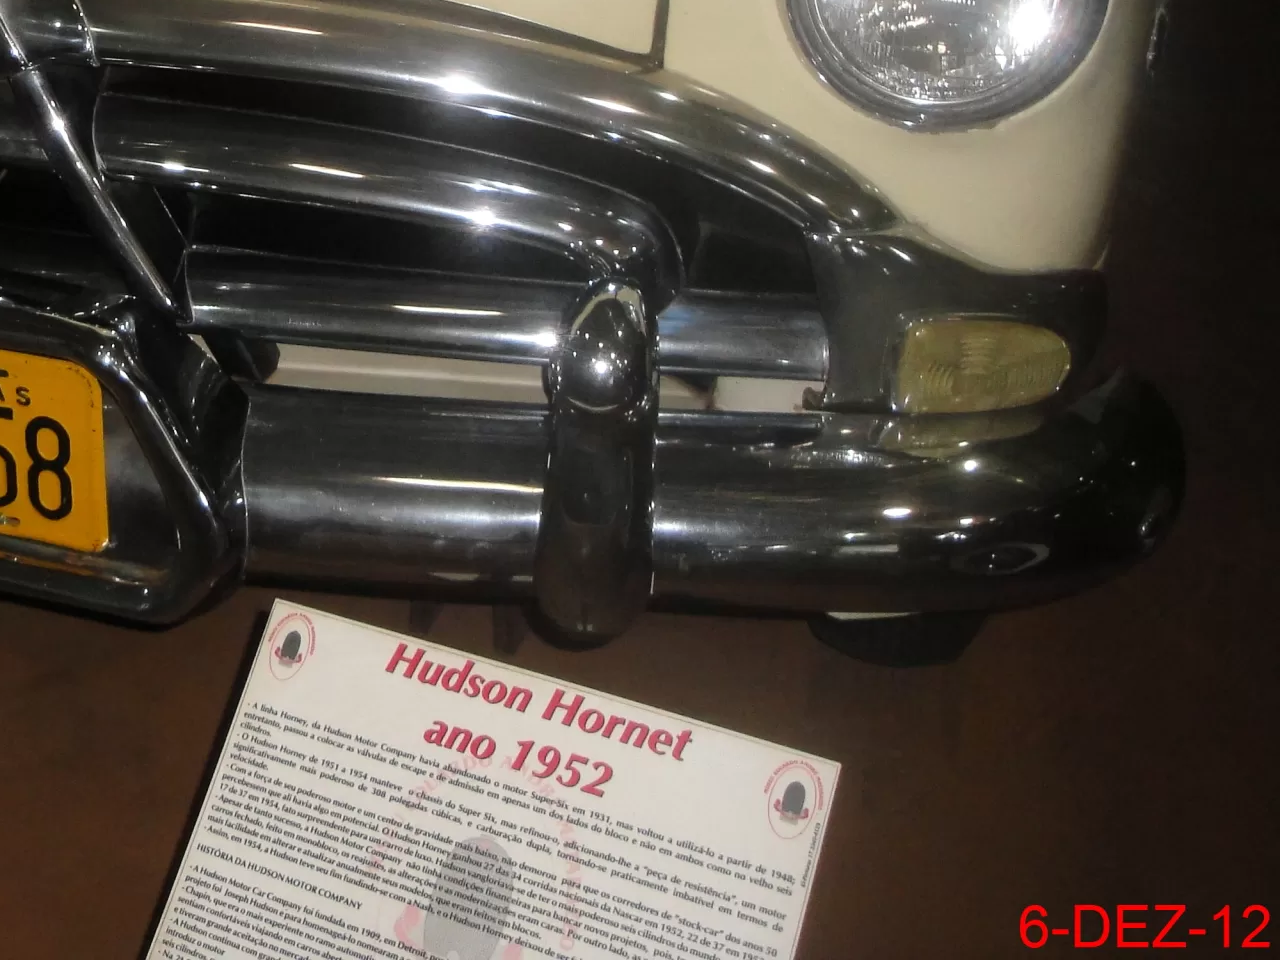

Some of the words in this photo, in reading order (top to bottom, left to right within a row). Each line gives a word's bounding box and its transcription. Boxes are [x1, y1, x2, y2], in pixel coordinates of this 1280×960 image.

[239, 721, 272, 738] cilindros.
[384, 642, 533, 713] Hudson
[541, 688, 693, 762] Hornet
[229, 752, 269, 771] velocidade.
[243, 711, 282, 730] entretanto,
[282, 724, 309, 738] passou
[309, 733, 316, 741] a
[316, 735, 346, 749] colocar
[345, 745, 355, 753] as
[388, 757, 399, 767] de
[400, 762, 428, 777] escape
[428, 771, 435, 779] e
[435, 772, 448, 783] de
[486, 790, 500, 801] em
[501, 795, 531, 810] apenas
[532, 805, 547, 816] um
[548, 809, 564, 822] dos
[565, 814, 589, 829] lados
[590, 823, 603, 834] do
[604, 826, 630, 843] bloco
[658, 847, 673, 857] em
[674, 852, 704, 868] ambos
[706, 862, 732, 876] como
[733, 871, 747, 881] no
[749, 876, 774, 890] velho
[776, 885, 793, 897] seis
[251, 701, 258, 711] A
[259, 703, 279, 717] linha
[279, 710, 309, 728] Horney,
[311, 720, 322, 731] da
[322, 724, 353, 741] Hudson
[353, 734, 379, 749] Motor
[380, 742, 418, 763] Company
[418, 754, 441, 769] havia
[441, 763, 492, 785] abandonado
[493, 780, 500, 788] o
[502, 783, 529, 797] motor
[530, 790, 570, 811] Super-Six
[571, 806, 586, 817] em
[589, 810, 613, 826] 1931,
[615, 820, 634, 832] mas
[636, 826, 665, 842] voltou
[666, 837, 673, 845] a
[717, 853, 724, 861] a
[725, 856, 753, 870] partir
[754, 863, 767, 875] de
[771, 869, 796, 886] 1948;
[423, 719, 497, 759] ano
[510, 739, 614, 798] 1952
[229, 762, 247, 775] Com
[253, 769, 273, 784] força
[272, 777, 284, 788] de
[283, 782, 297, 792] seu
[295, 787, 332, 804] poderoso
[332, 799, 357, 812] motor
[356, 807, 363, 815] e
[362, 809, 377, 820] um
[376, 814, 403, 829] centro
[403, 821, 415, 833] de
[413, 827, 454, 846] gravidade
[454, 841, 474, 853] mais
[474, 845, 500, 863] baixo,
[518, 861, 558, 882] demorou
[560, 877, 582, 891] para
[582, 885, 600, 896] que
[599, 891, 611, 900] os
[611, 895, 660, 917] corredores
[660, 910, 673, 921] de
[724, 932, 741, 945] dos
[742, 940, 764, 953] anos
[764, 946, 778, 958] 50
[232, 740, 297, 769] significativamente
[299, 764, 317, 776] mais
[318, 771, 355, 788] poderoso
[357, 782, 369, 793] de
[370, 787, 387, 799] 308
[388, 794, 429, 813] polegadas
[466, 820, 473, 828] e
[525, 839, 553, 856] dupla,
[556, 849, 608, 873] tornando-se
[609, 868, 669, 894] praticamente
[717, 905, 733, 916] em
[736, 910, 768, 928] termos
[771, 922, 784, 933] de
[241, 732, 250, 741] O
[250, 734, 279, 751] Hudson
[279, 744, 308, 762] Horney
[308, 754, 319, 765] de
[321, 758, 340, 772] 1951
[349, 768, 368, 781] 1954
[369, 776, 403, 793] manteve
[415, 790, 444, 806] chassis
[444, 799, 457, 810] do
[457, 803, 482, 818] Super
[482, 811, 498, 825] Six,
[499, 819, 518, 831] mas
[562, 840, 632, 869] adicionando-lhe
[633, 864, 640, 872] a
[669, 874, 683, 886] de
[740, 900, 757, 911] um
[758, 906, 787, 921] motor
[184, 874, 212, 890] projeto
[211, 882, 223, 894] foi
[223, 887, 250, 905] Joseph
[249, 897, 279, 916] Hudson
[278, 910, 285, 918] e
[283, 912, 302, 925] para
[355, 939, 400, 960] nomearam
[192, 864, 199, 873] A
[199, 866, 228, 884] Hudson
[227, 877, 252, 892] Motor
[251, 886, 267, 898] Car
[266, 891, 303, 913] Company
[302, 904, 315, 916] foi
[314, 909, 346, 929] fundada
[346, 923, 360, 934] em
[383, 937, 397, 948] em
[233, 856, 247, 869] DA
[246, 861, 286, 882] HUDSON
[284, 875, 318, 895] MOTOR
[317, 887, 363, 911] COMPANY
